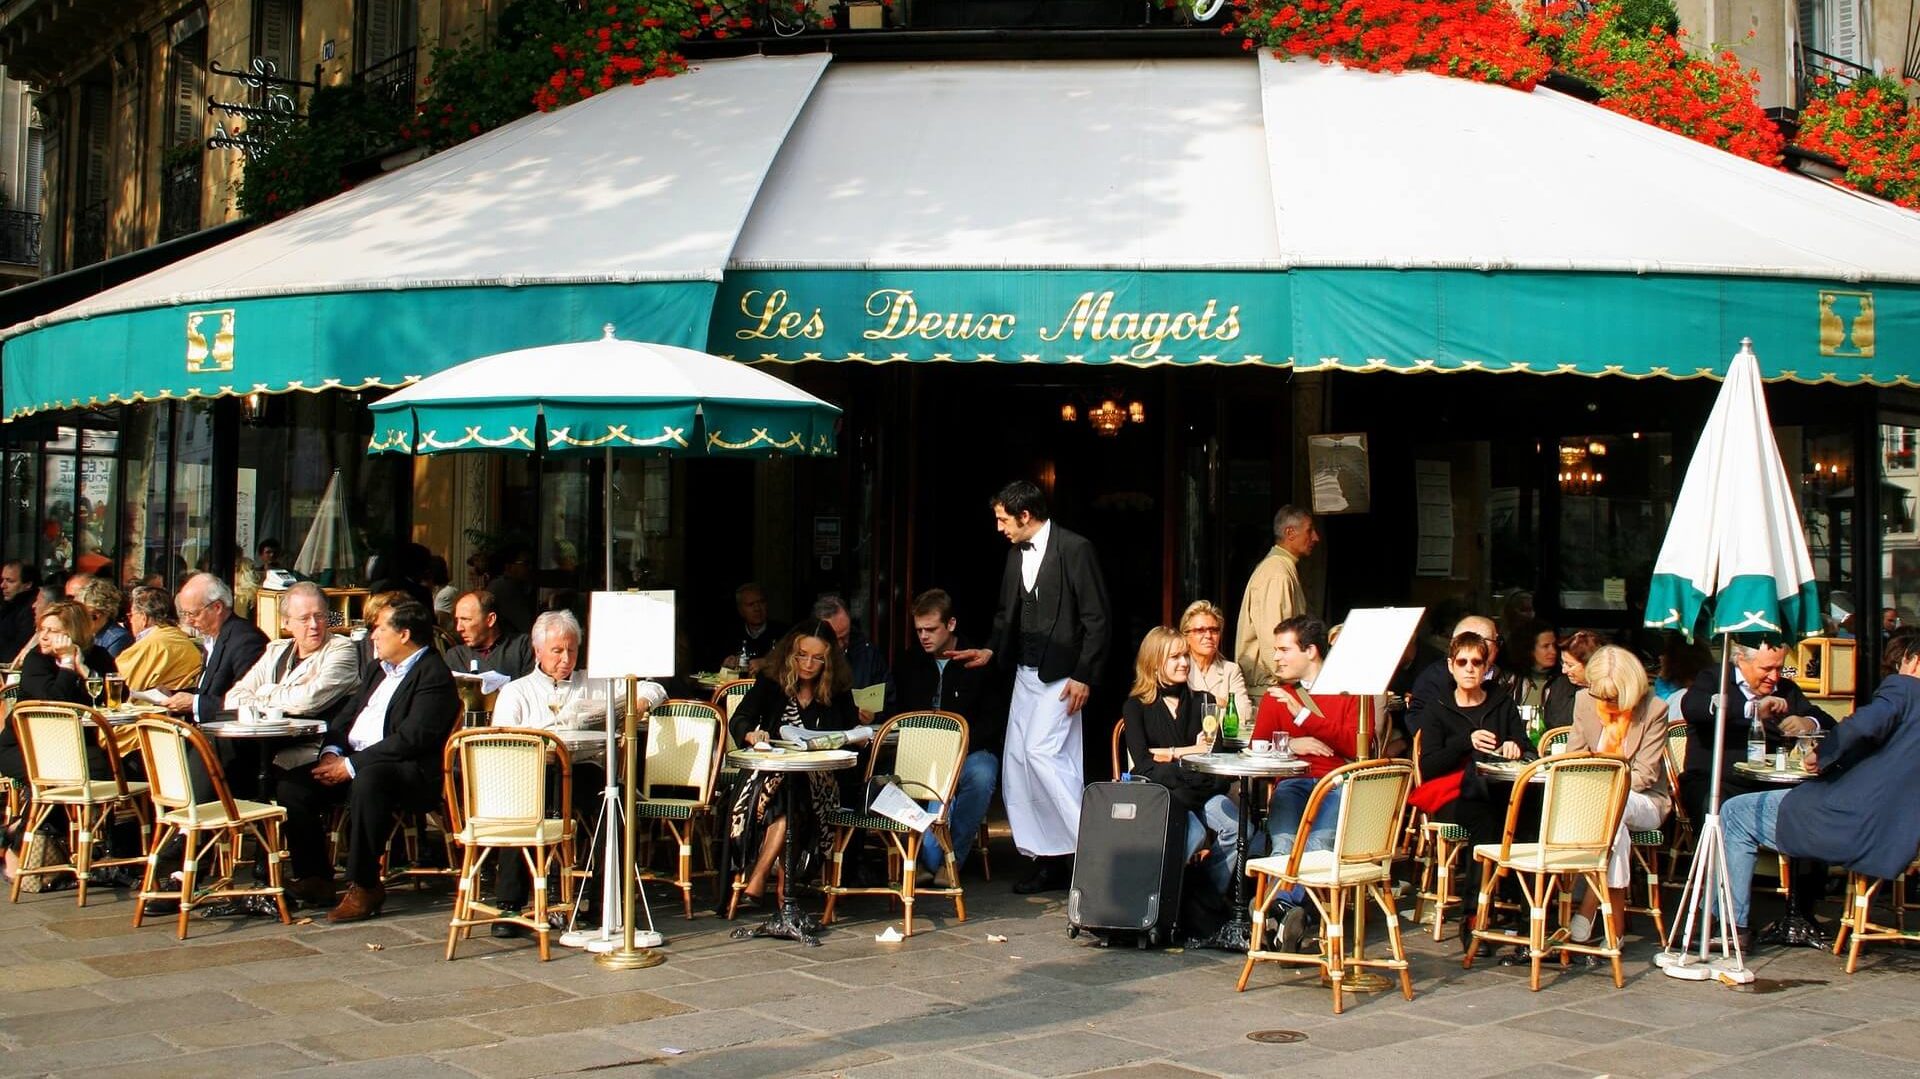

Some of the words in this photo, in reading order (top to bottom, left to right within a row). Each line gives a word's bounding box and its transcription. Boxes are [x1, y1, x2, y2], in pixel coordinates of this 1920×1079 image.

[735, 288, 825, 340] Les
[863, 288, 1015, 341] Deux
[1038, 290, 1241, 360] Magots
